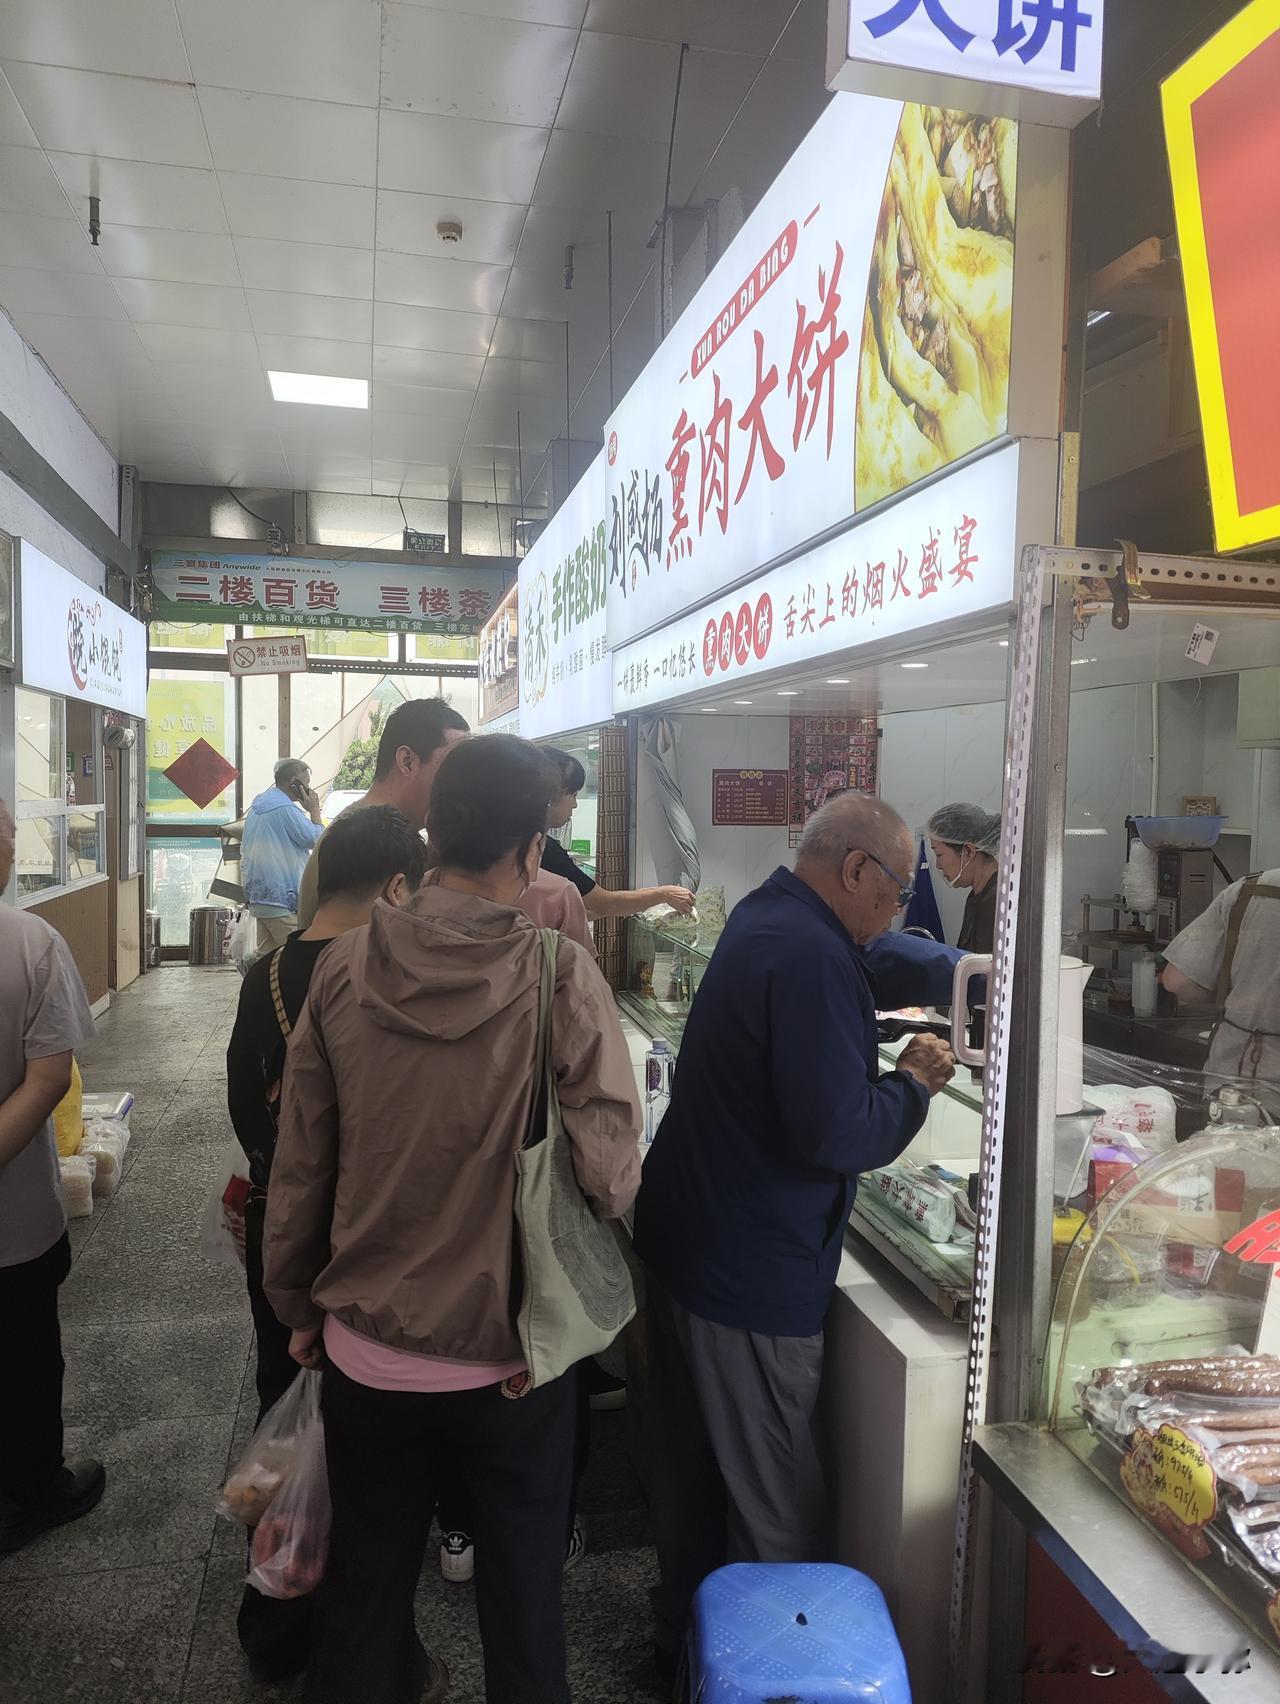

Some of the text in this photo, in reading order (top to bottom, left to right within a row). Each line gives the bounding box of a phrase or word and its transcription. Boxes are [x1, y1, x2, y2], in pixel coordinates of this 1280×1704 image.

[696, 235, 789, 370] XUN ROU DA BING
[665, 240, 849, 572] 熏肉大饼
[222, 562, 262, 571] Anywide
[551, 519, 607, 645] 手作酸奶
[175, 574, 503, 616] 二楼百货 三楼茶
[703, 514, 979, 677] 熏肉大饼 舌尖上的烟火盛宴
[238, 611, 423, 630] 由扶梯和观光梯可直达二楼百货
[255, 644, 302, 658] 禁止吸烟
[271, 658, 301, 667] Smoking
